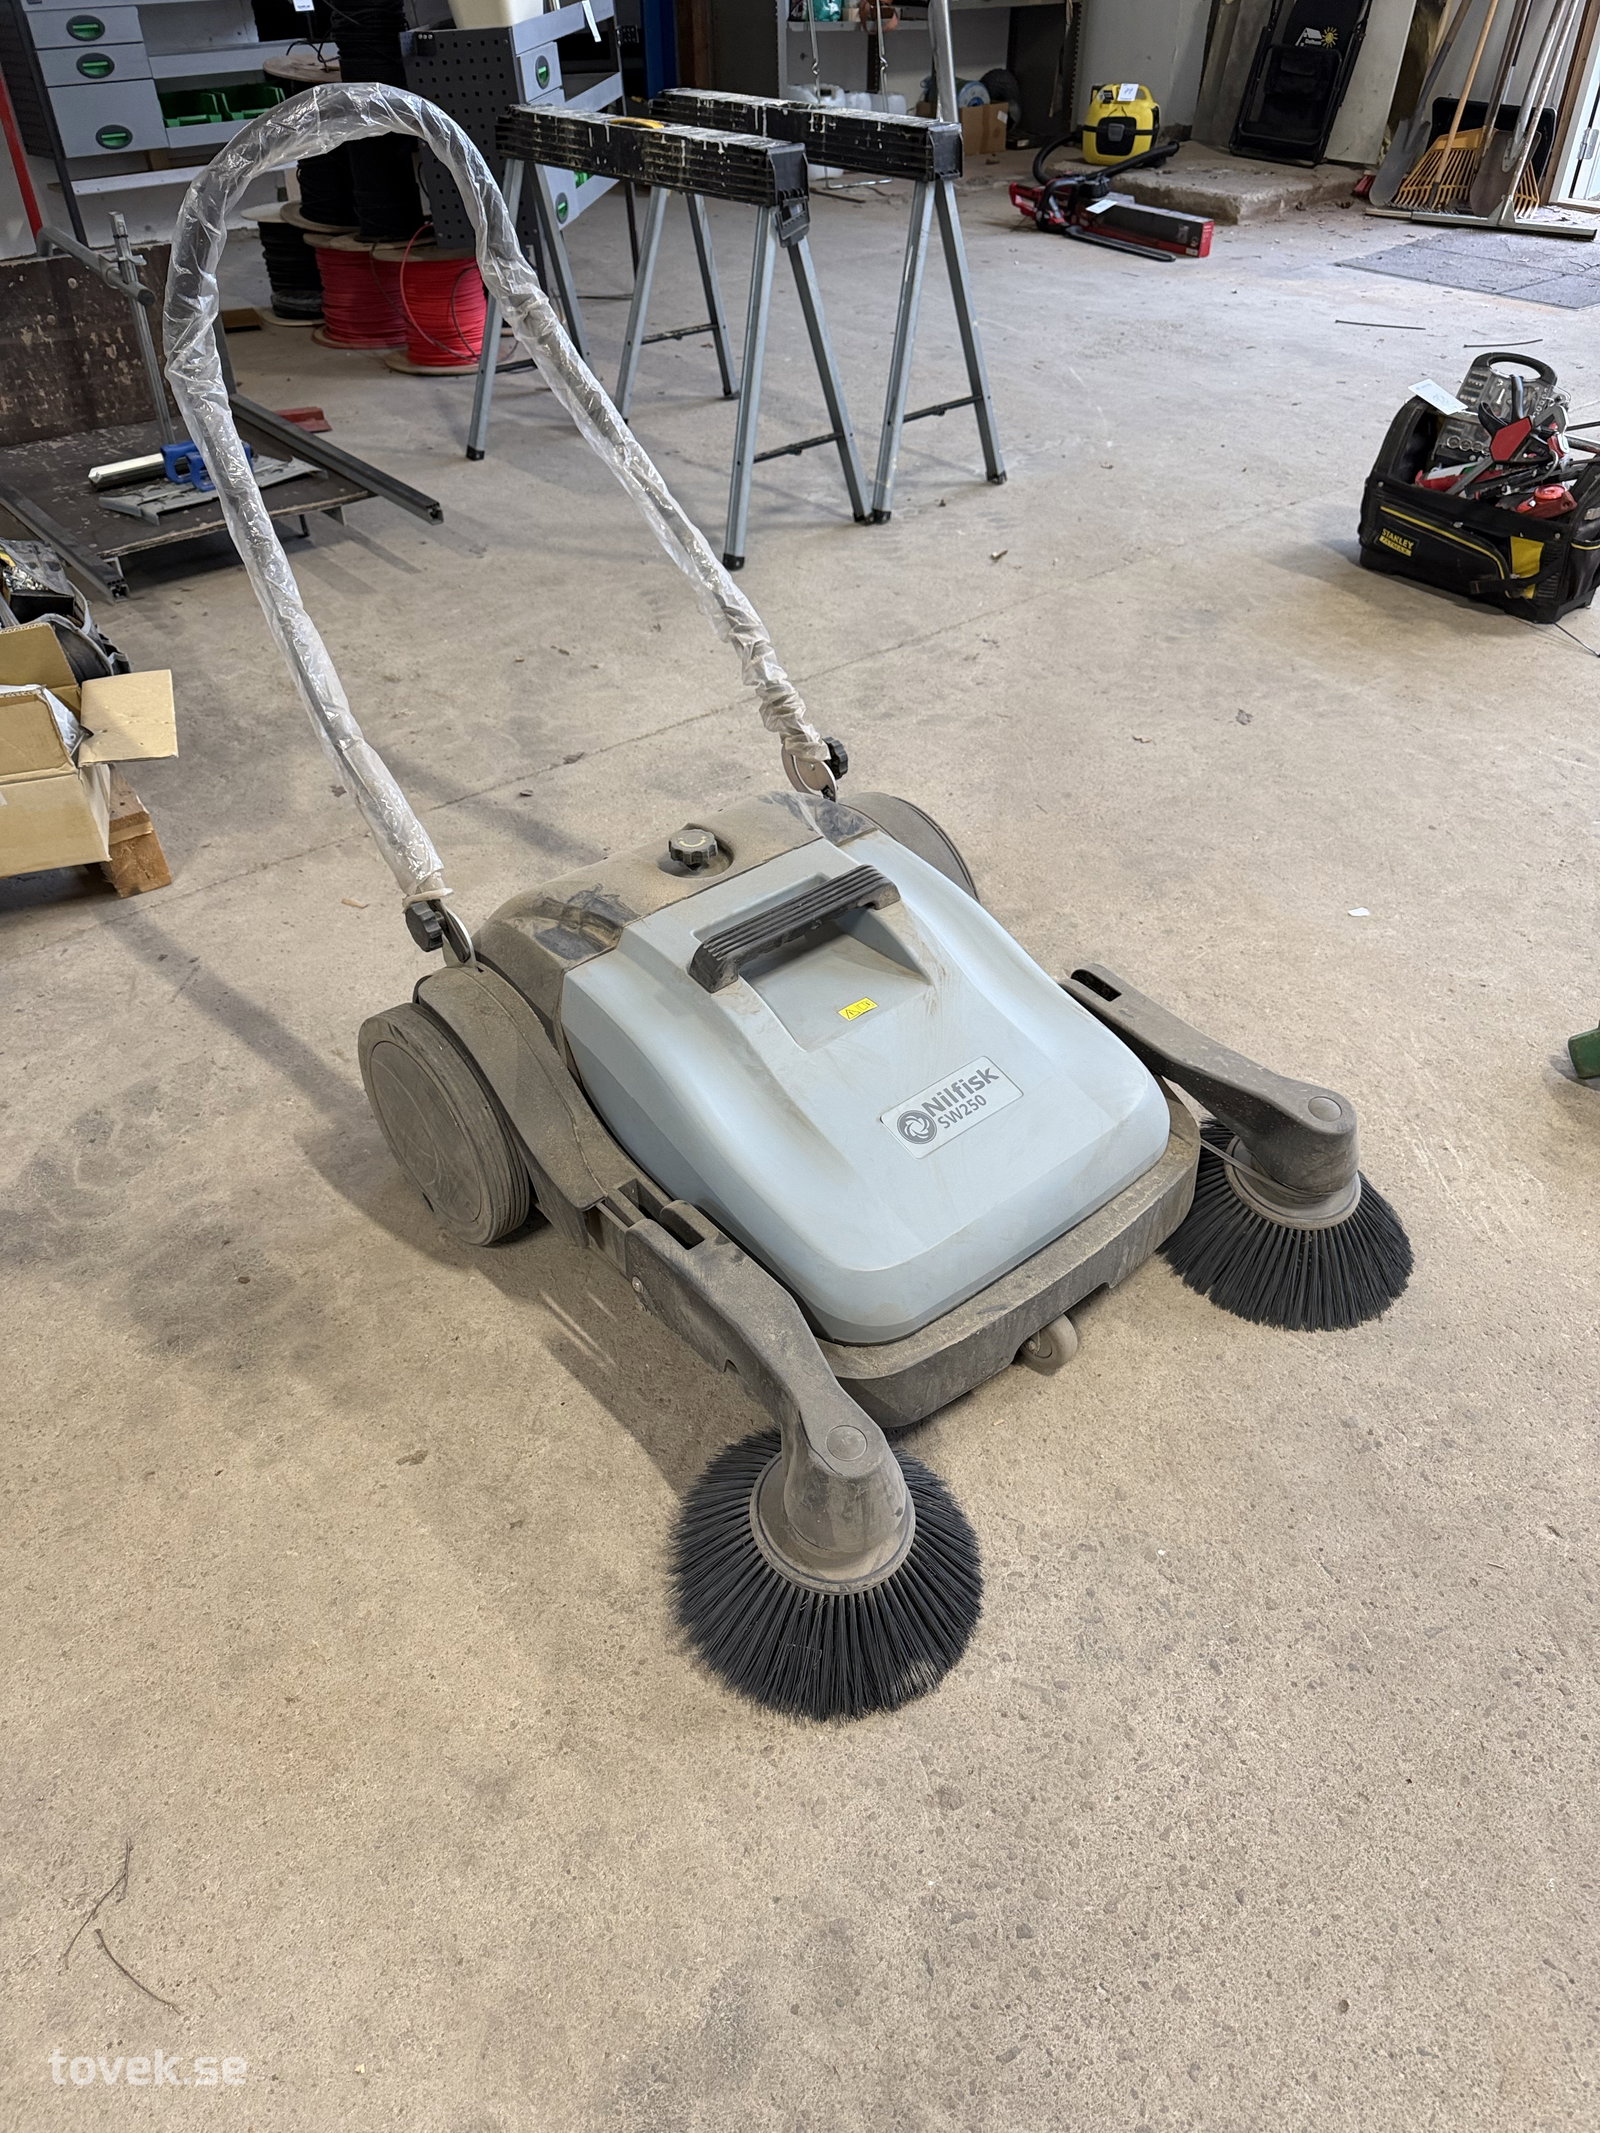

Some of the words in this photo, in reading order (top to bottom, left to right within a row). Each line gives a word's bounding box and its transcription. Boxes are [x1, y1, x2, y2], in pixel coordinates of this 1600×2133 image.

[1381, 528, 1415, 549] STANLEY
[921, 1067, 1000, 1118] Nilfisk
[937, 1094, 987, 1129] SW250
